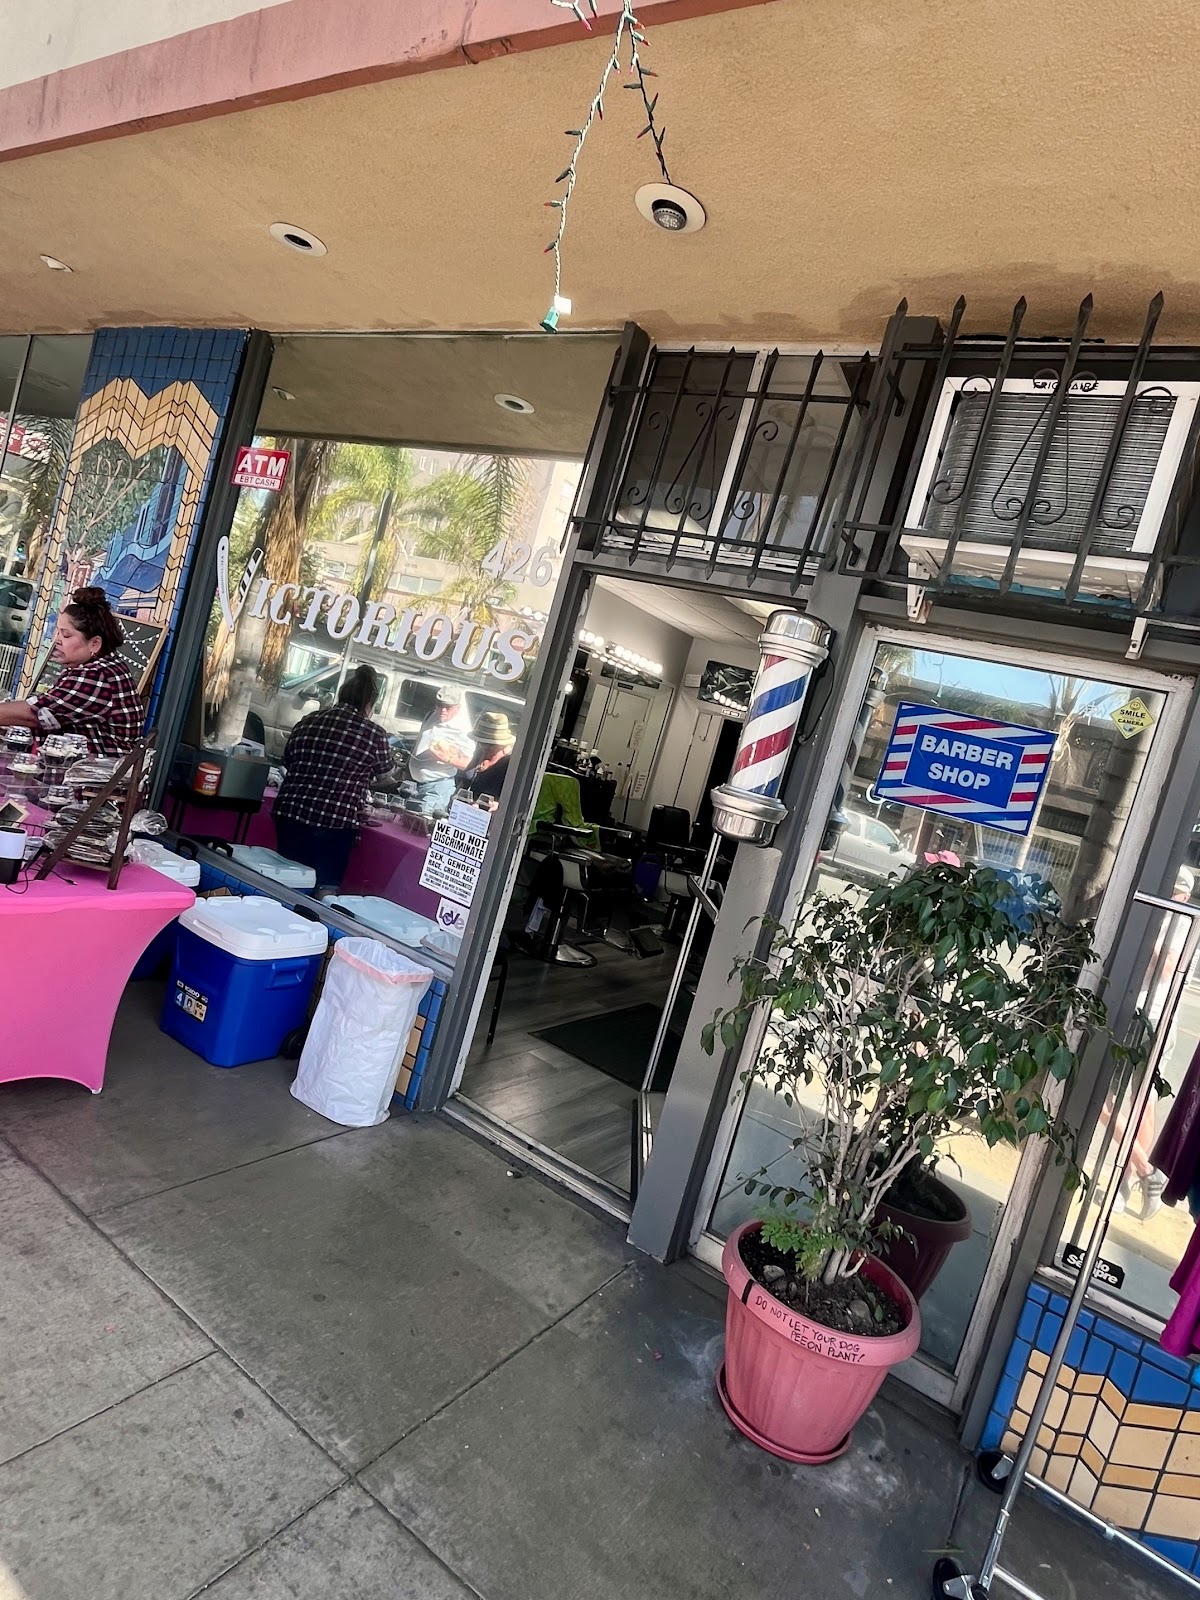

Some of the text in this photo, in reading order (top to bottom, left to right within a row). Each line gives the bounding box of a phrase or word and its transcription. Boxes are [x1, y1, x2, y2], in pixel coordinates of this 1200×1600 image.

[1033, 381, 1099, 391] FRIGAIRE
[237, 453, 286, 477] ATM
[239, 475, 275, 487] EBT CASH
[481, 537, 557, 588] 426
[1117, 718, 1144, 727] CAMERA
[1119, 709, 1146, 719] SMILE
[920, 734, 1014, 771] BARBER
[927, 762, 991, 790] SHOP
[433, 831, 484, 860] DISCRIMINATE
[436, 822, 487, 850] WE DO NOT
[1066, 1253, 1118, 1284] Sepre
[1079, 1252, 1110, 1273] lo
[755, 1295, 860, 1352] DO NOT LET YOUR DOG
[827, 1346, 866, 1363] PLANT!
